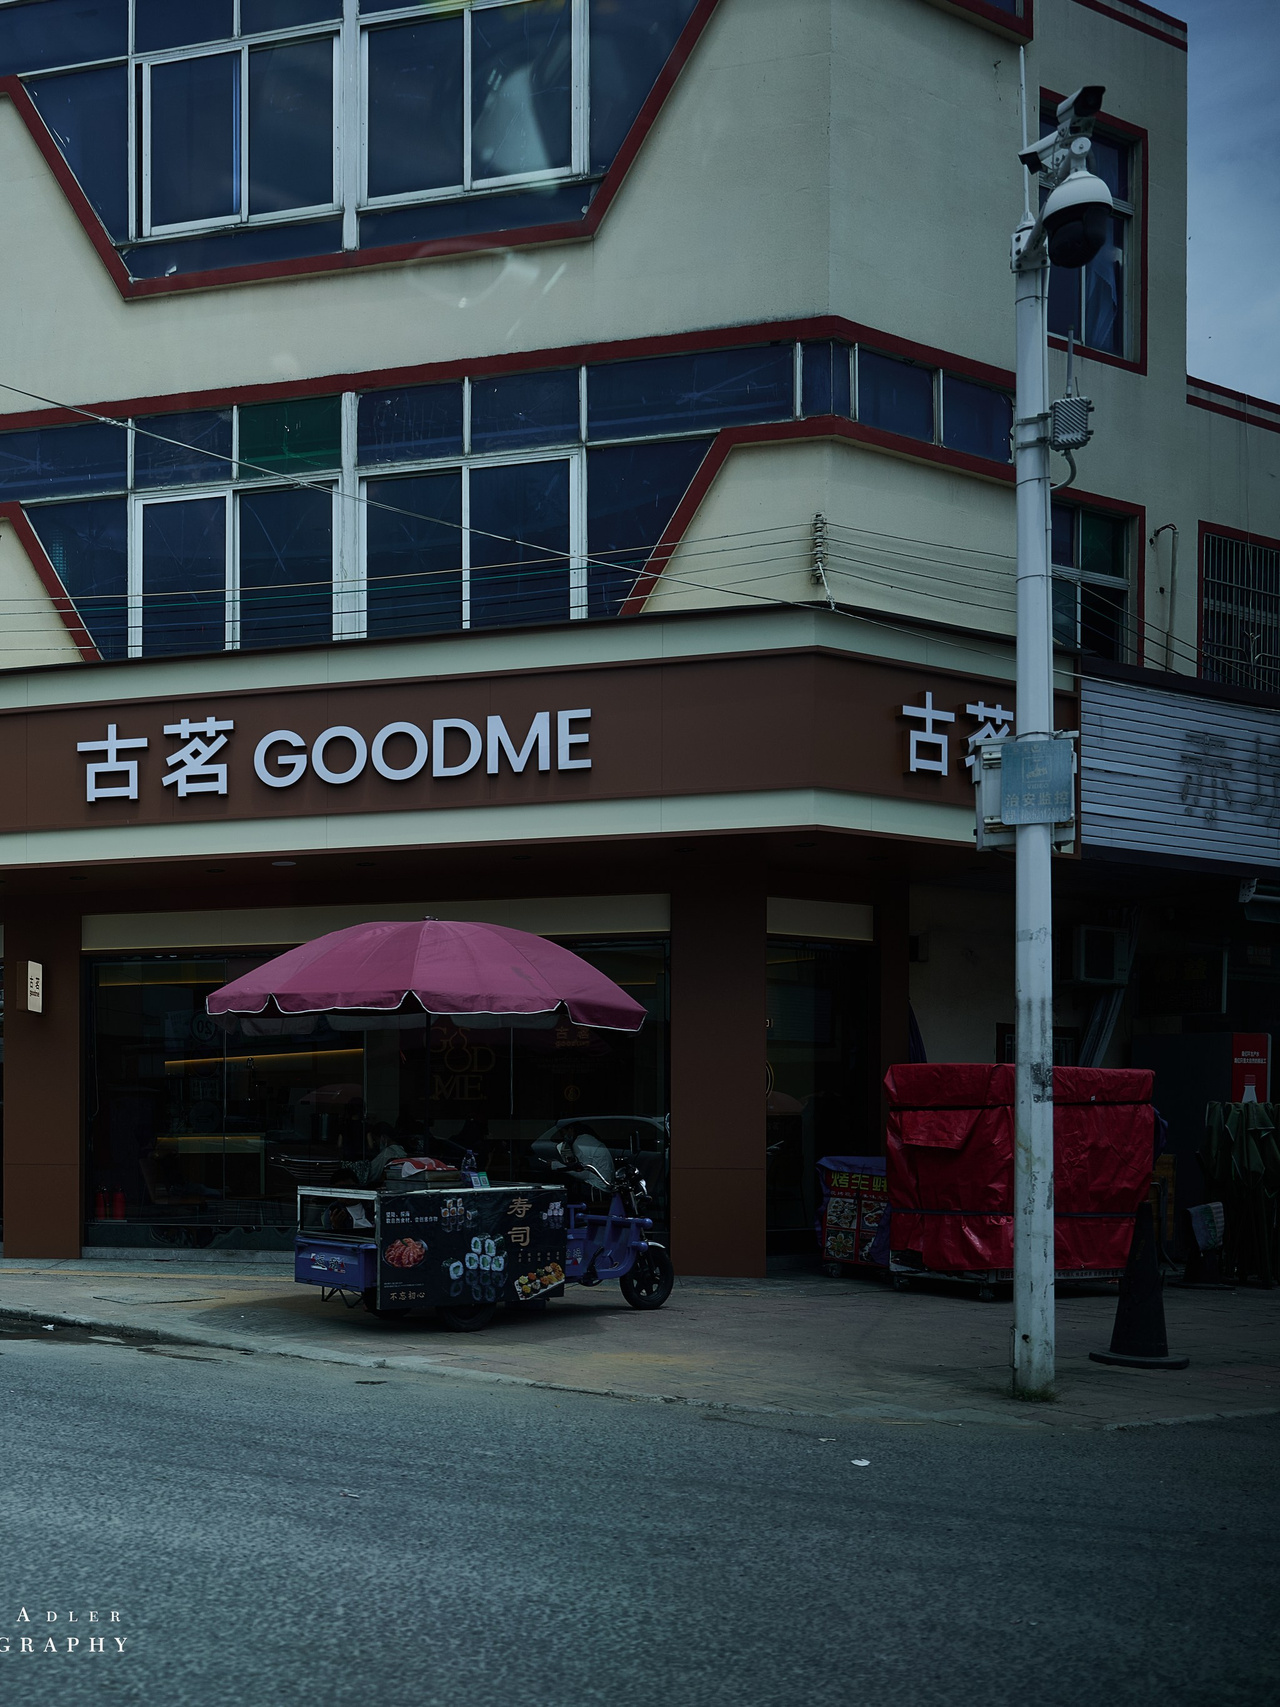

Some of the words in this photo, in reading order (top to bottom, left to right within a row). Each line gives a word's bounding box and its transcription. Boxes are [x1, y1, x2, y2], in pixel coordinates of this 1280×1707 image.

[76, 717, 235, 802] 古茗
[253, 708, 592, 788] GOODME
[1005, 791, 1069, 807] 治安监控
[507, 1196, 533, 1248] 寿司
[389, 1290, 426, 1301] 不忘初心
